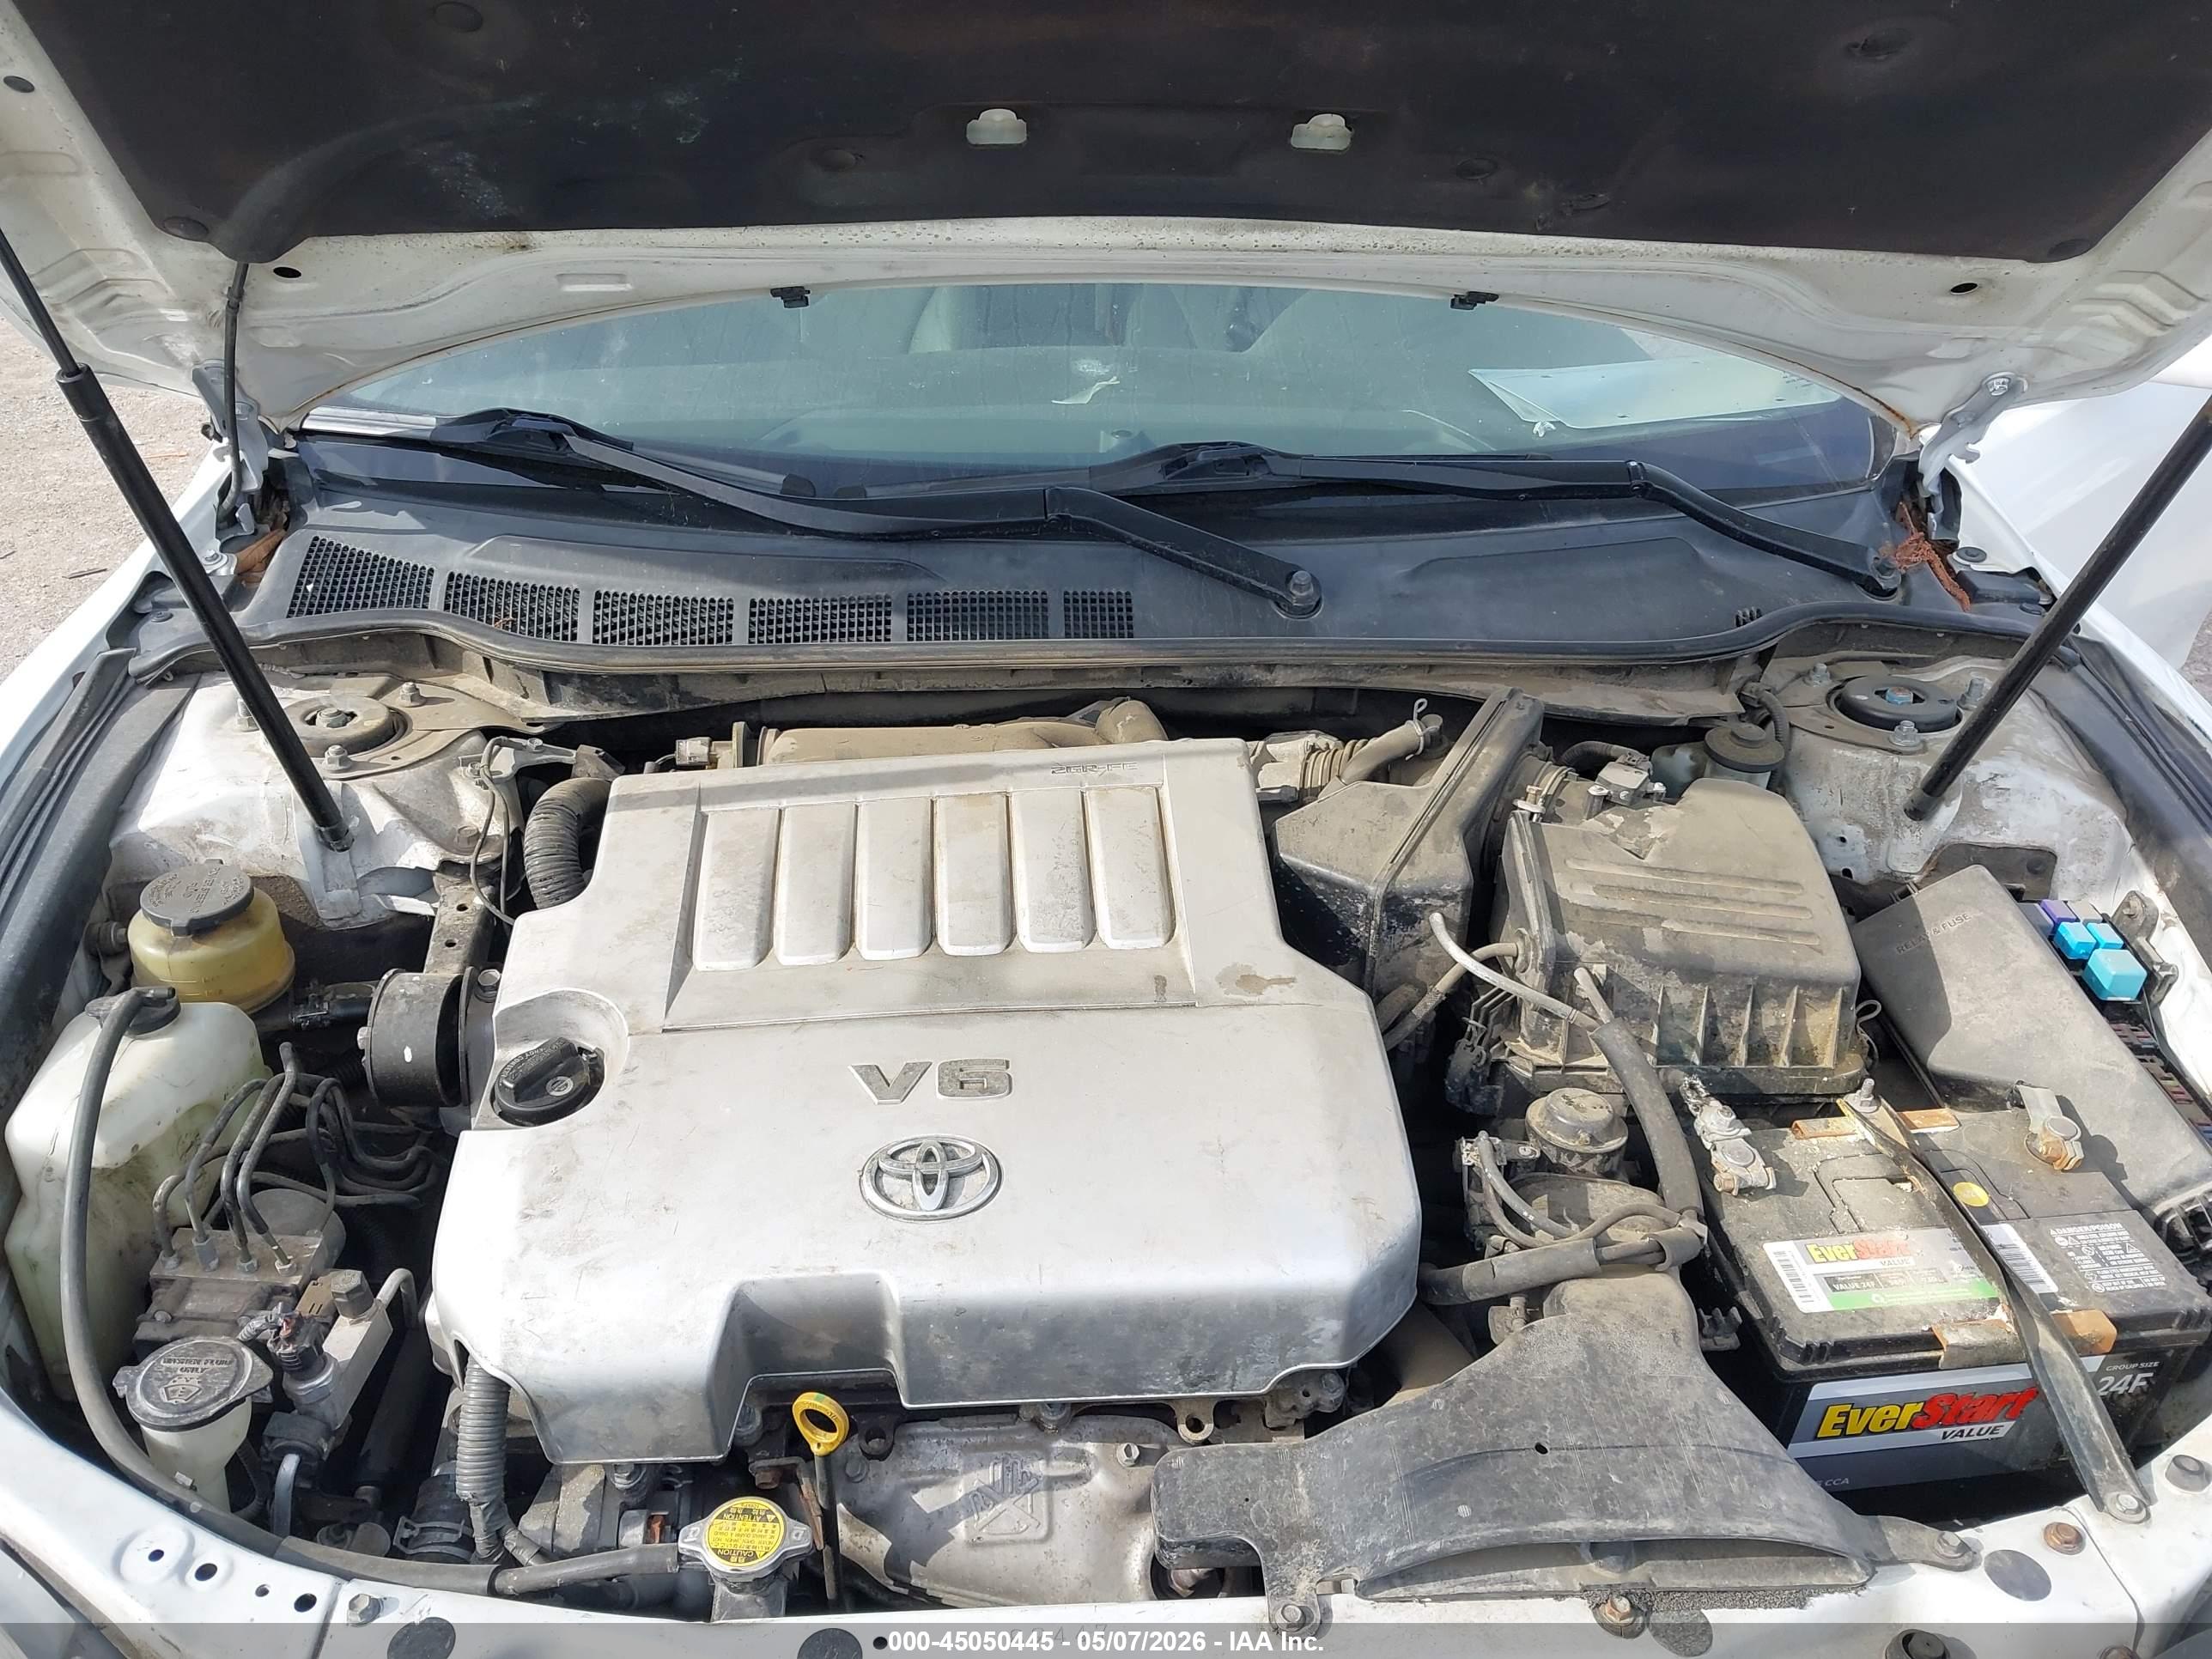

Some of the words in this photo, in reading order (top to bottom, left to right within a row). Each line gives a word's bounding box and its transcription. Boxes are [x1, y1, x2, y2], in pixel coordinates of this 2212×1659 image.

[1896, 931, 1929, 954] RELAY
[1942, 913, 1972, 931] FUSE
[848, 1058, 1013, 1105] V6
[1806, 1238, 1911, 1263] EverStart
[1880, 1258, 1910, 1267] VALUE
[2106, 1364, 2138, 1372] GROUP
[2097, 1372, 2154, 1396] 24F
[1815, 1386, 2039, 1440] EverStart
[1941, 1425, 2002, 1441] VALUE
[1825, 1477, 1849, 1486] CCA
[723, 1513, 761, 1522] ATTENTION
